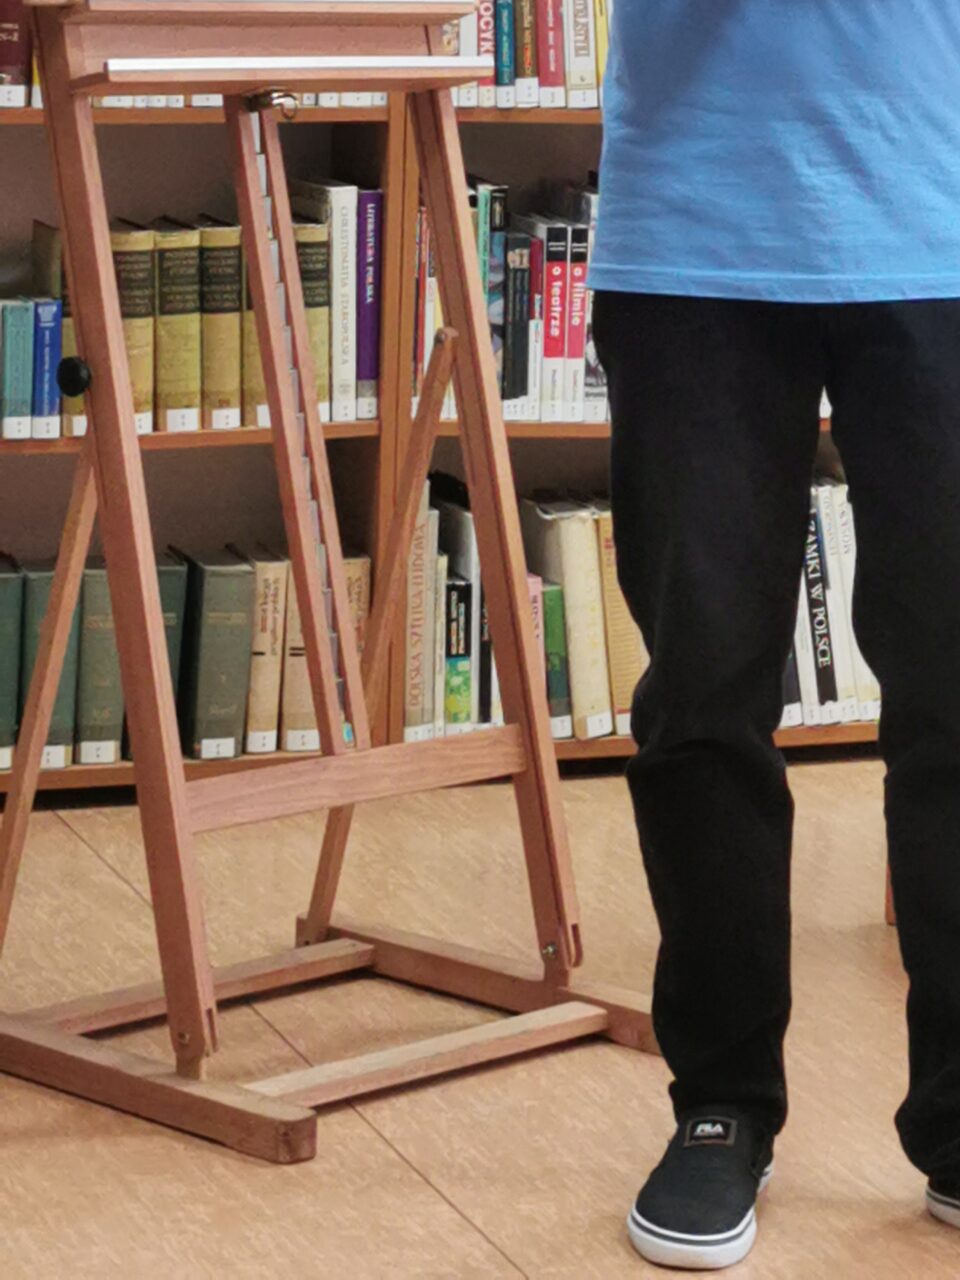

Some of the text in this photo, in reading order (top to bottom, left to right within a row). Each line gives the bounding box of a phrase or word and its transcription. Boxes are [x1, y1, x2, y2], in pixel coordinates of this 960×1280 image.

[552, 266, 562, 276] o
[573, 267, 583, 277] o
[809, 583, 823, 602] W
[812, 607, 830, 668] POLSCE
[696, 1122, 725, 1133] FILA
